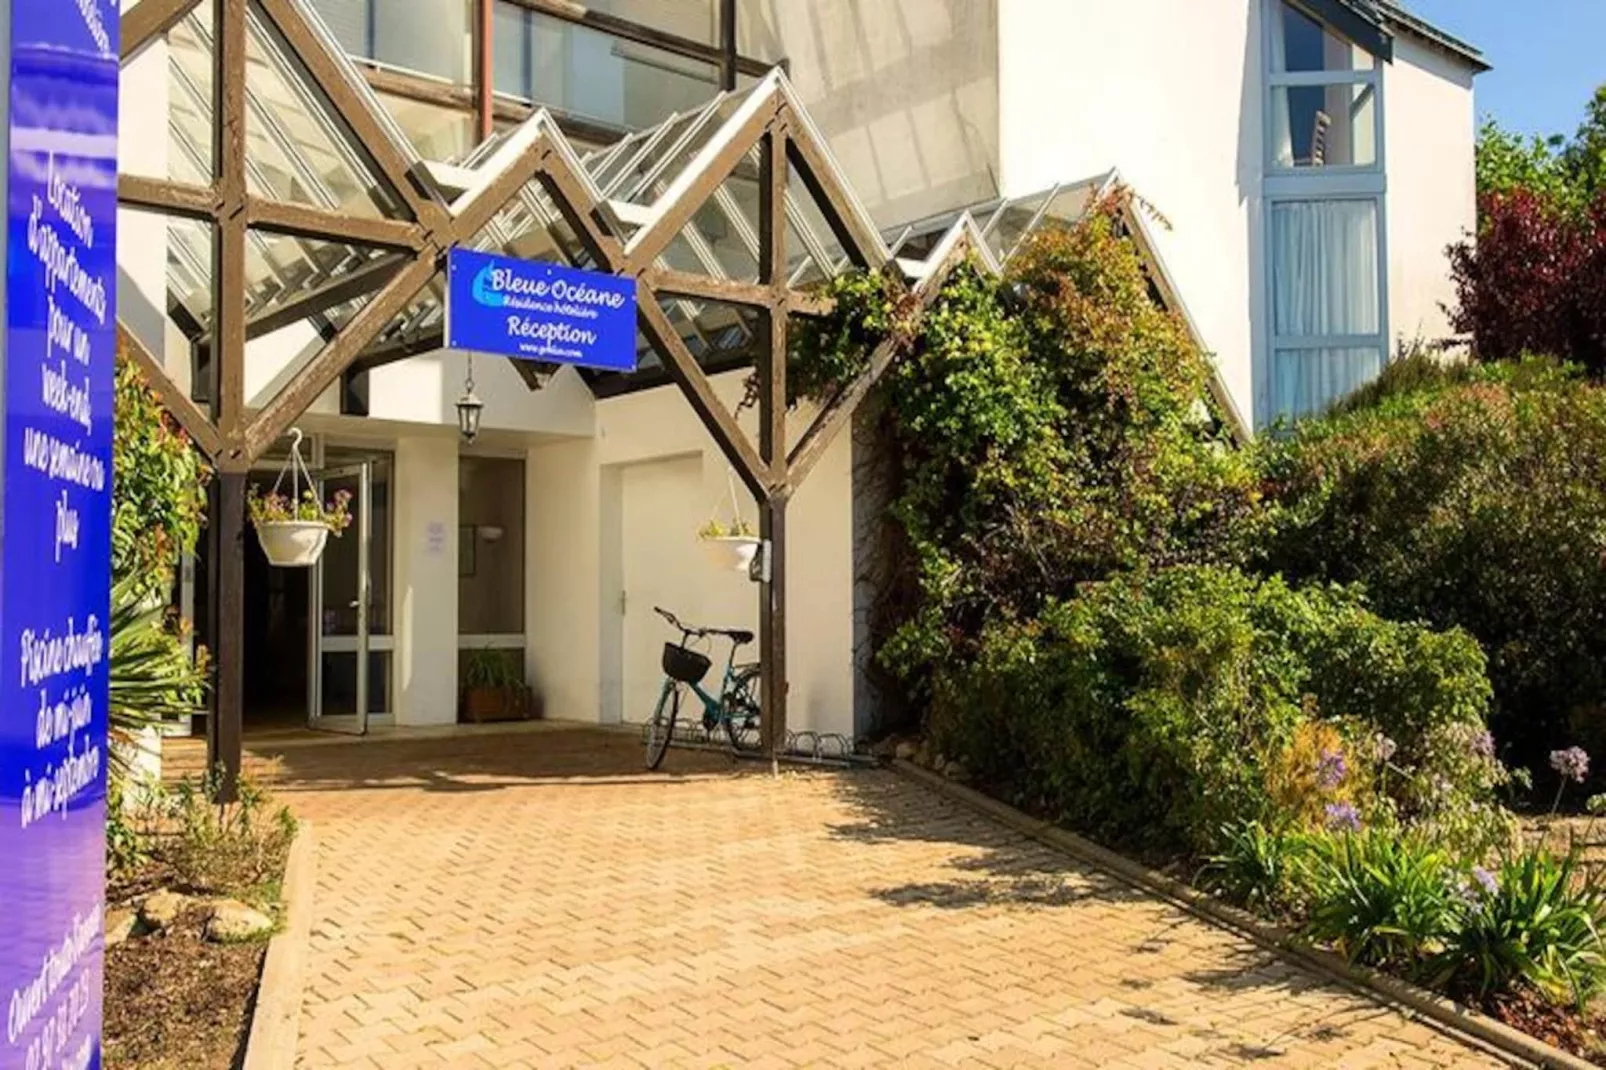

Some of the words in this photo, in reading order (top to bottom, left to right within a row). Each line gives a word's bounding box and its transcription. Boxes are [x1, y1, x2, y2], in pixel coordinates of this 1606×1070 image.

[491, 268, 549, 297] Bleue
[551, 280, 625, 309] Océane
[507, 315, 598, 347] Réception
